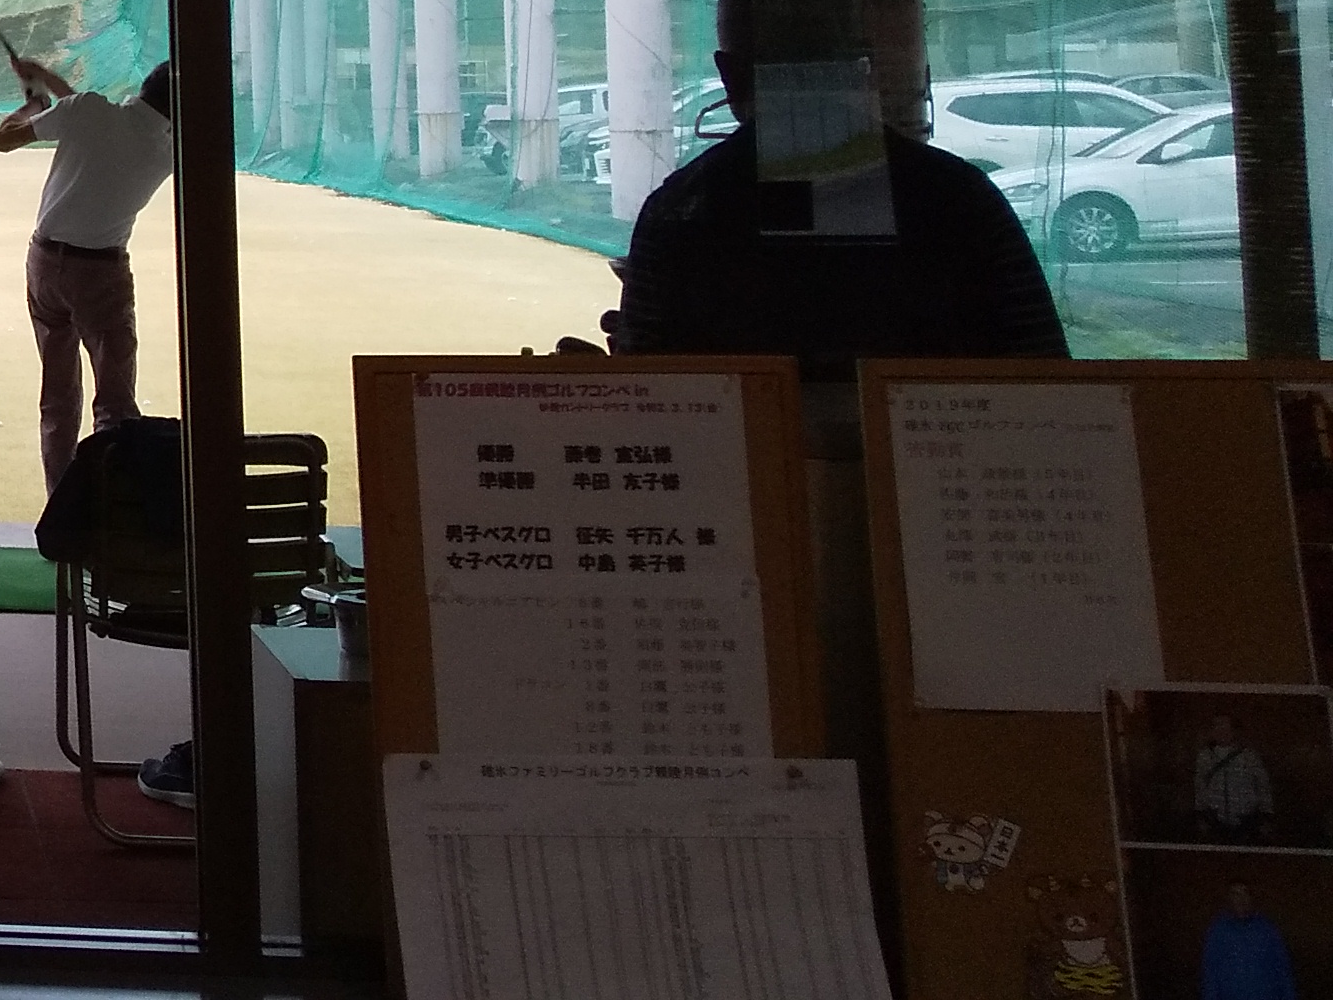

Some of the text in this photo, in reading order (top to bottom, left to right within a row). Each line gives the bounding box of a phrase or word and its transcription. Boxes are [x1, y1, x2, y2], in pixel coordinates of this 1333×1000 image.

[479, 471, 535, 490] 準優勝
[445, 524, 552, 543] 男子ベスグロ
[696, 527, 716, 545] 様
[446, 552, 553, 571] 女子ベスグロ
[991, 826, 1014, 861] 日本一
